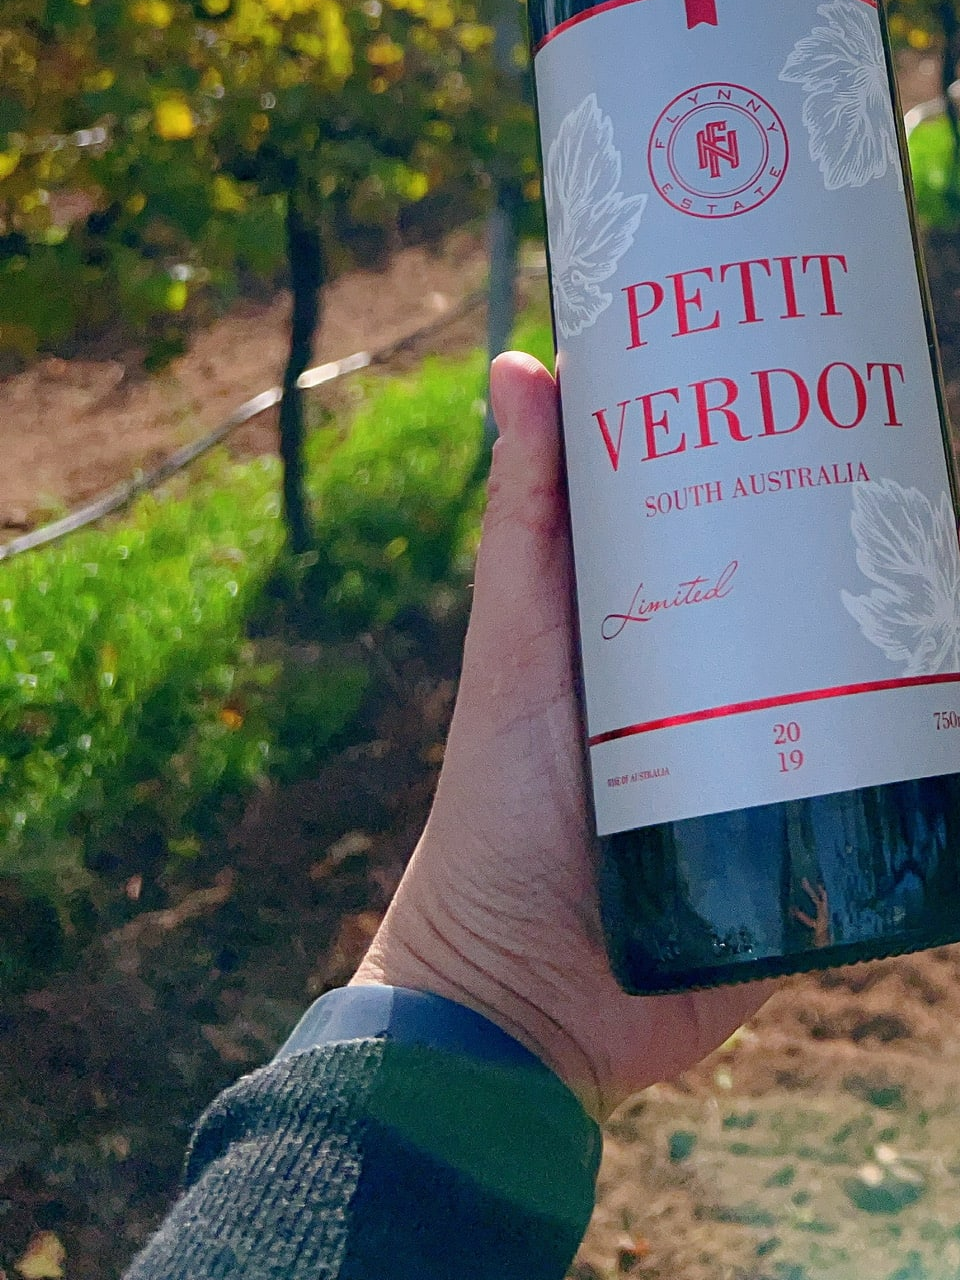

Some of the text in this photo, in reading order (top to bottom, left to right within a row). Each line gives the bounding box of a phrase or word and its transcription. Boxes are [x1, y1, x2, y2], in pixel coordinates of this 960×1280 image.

[655, 89, 779, 149] FLYNNY
[661, 166, 782, 214] ESTATE
[621, 255, 847, 350] PETIT
[592, 362, 905, 472] VERDOT
[644, 462, 871, 518] SOUTH AUSTRALIA
[601, 560, 738, 640] Limited
[773, 721, 800, 745] 20
[778, 750, 804, 773] 19
